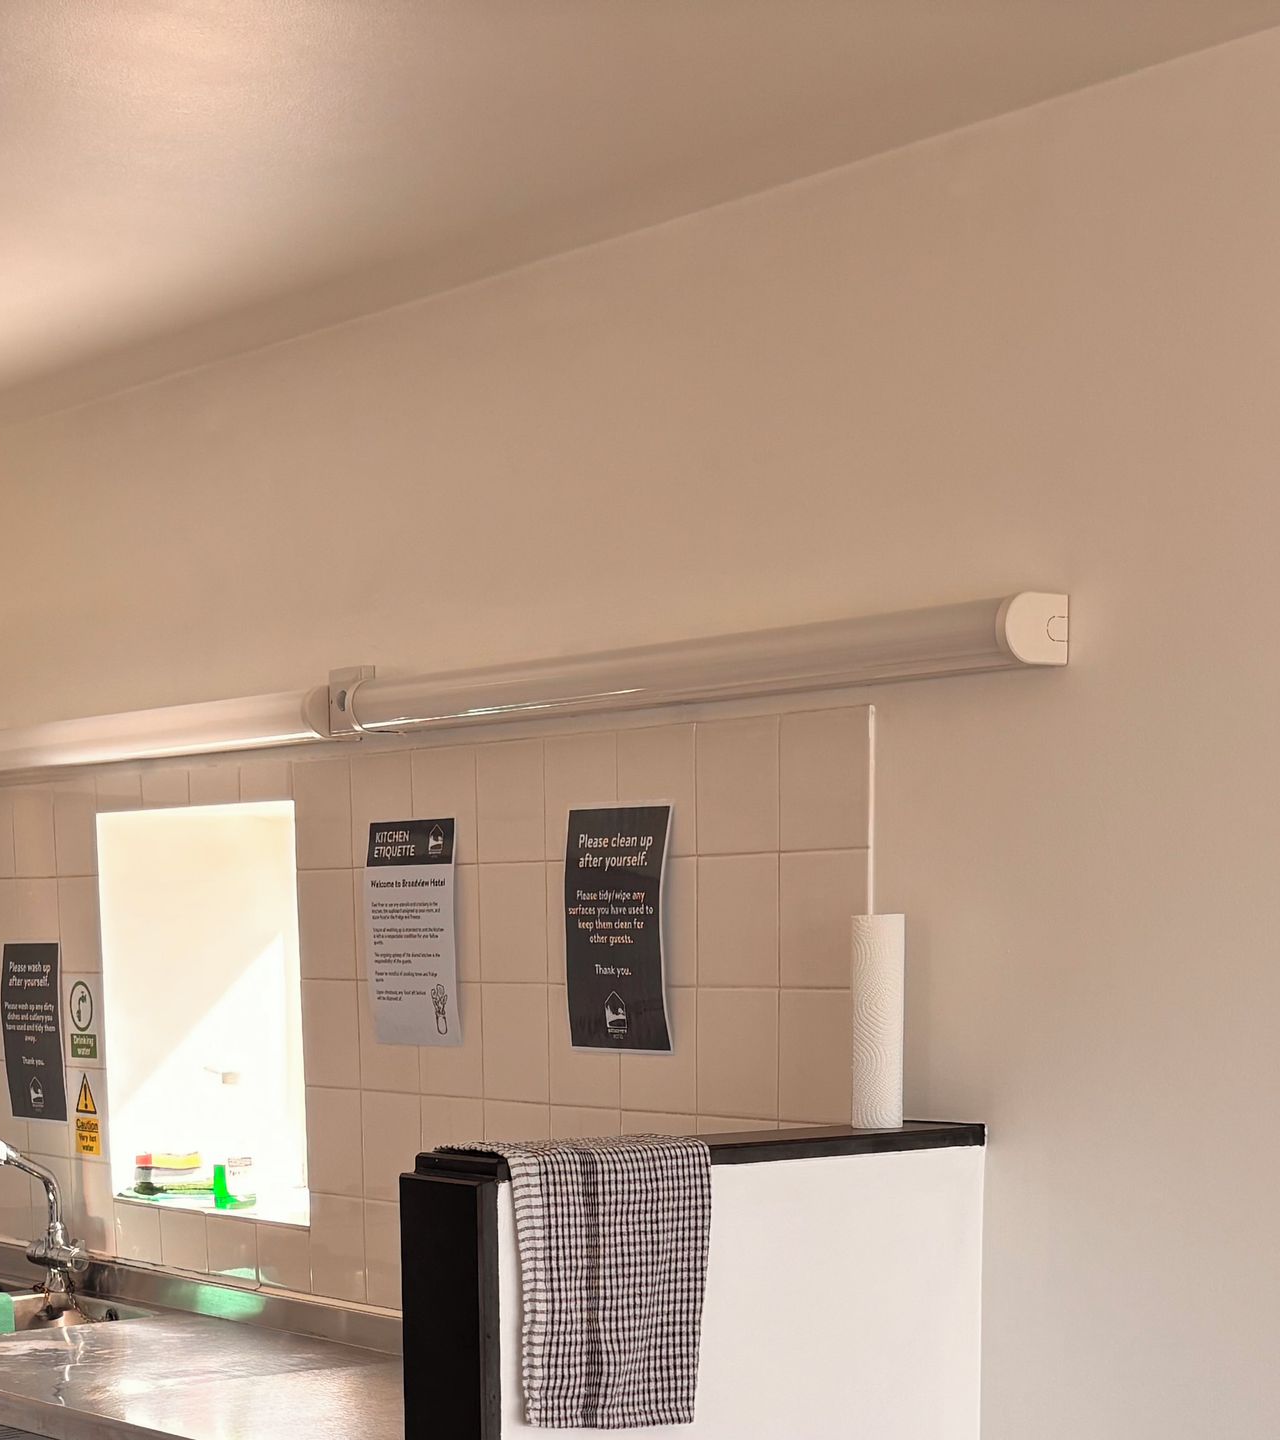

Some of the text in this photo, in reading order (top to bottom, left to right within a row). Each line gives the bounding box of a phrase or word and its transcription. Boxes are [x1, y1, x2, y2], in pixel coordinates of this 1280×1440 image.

[375, 830, 410, 843] KITCHEN
[578, 832, 653, 852] Please clean up
[374, 845, 415, 860] ETIQUETTE
[578, 851, 648, 871] after yourself.
[371, 880, 394, 888] Welcome
[395, 880, 401, 888] to
[430, 878, 446, 887] Hotel
[576, 889, 645, 905] Please tidy/wipe any
[568, 904, 654, 918] surfaces you have used to
[578, 919, 644, 932] keep them clean for
[589, 934, 634, 947] other guests.
[9, 961, 51, 977] Please wash up
[595, 964, 632, 978] Thank you.
[8, 975, 50, 990] after yourself.
[4, 1002, 55, 1013] Please wash up any dirty
[7, 1012, 20, 1021] dishes
[20, 1013, 29, 1021] and
[44, 1014, 53, 1023] you
[6, 1023, 56, 1034] have used and tidy them
[73, 1035, 94, 1047] Drinking
[77, 1047, 91, 1056] water
[22, 1056, 35, 1065] Thank
[76, 1118, 99, 1131] Caution
[89, 1134, 97, 1142] hot
